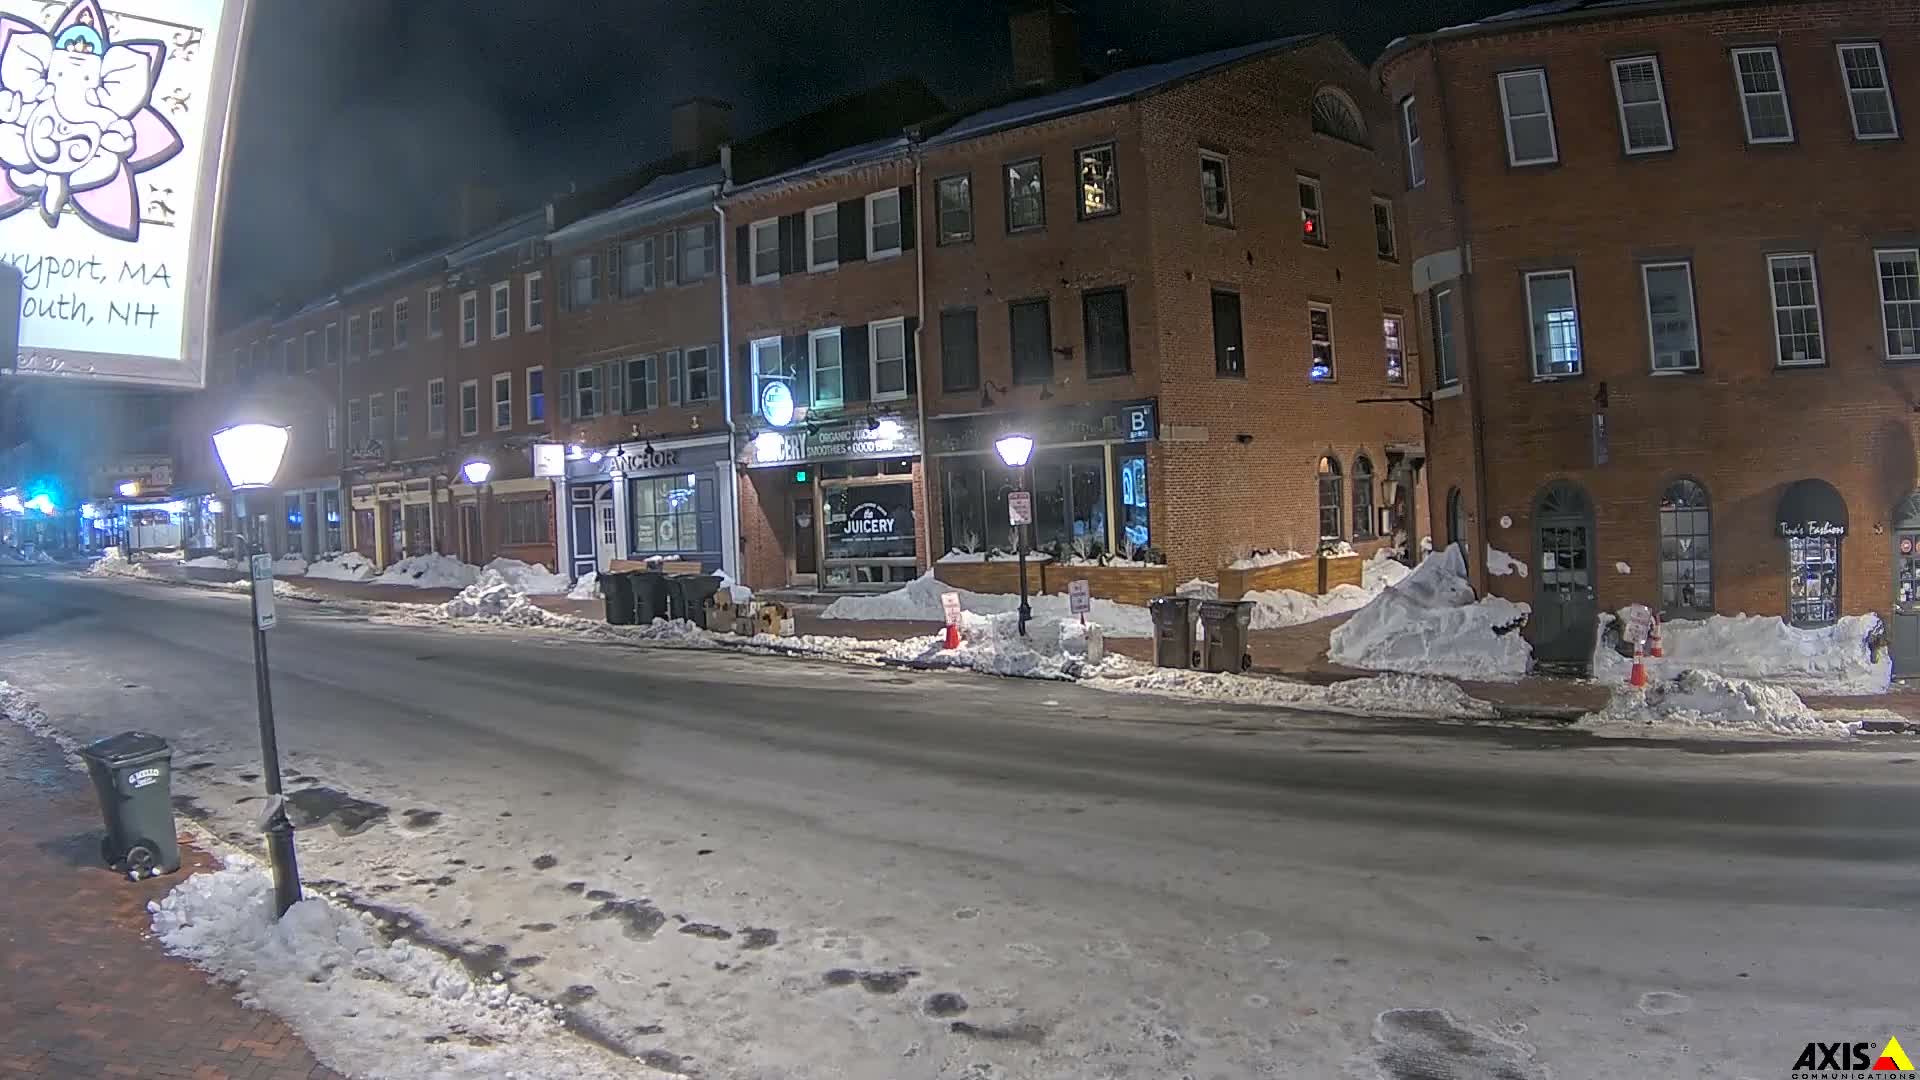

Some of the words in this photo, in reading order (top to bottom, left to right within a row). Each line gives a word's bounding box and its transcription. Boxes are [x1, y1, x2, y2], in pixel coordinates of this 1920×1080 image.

[119, 261, 171, 288] MA
[108, 301, 159, 329] NH
[819, 431, 850, 443] ORGANIC
[807, 443, 846, 457] SMOOTHIES
[610, 450, 677, 471] ANCHOR
[844, 519, 894, 534] JUICERY
